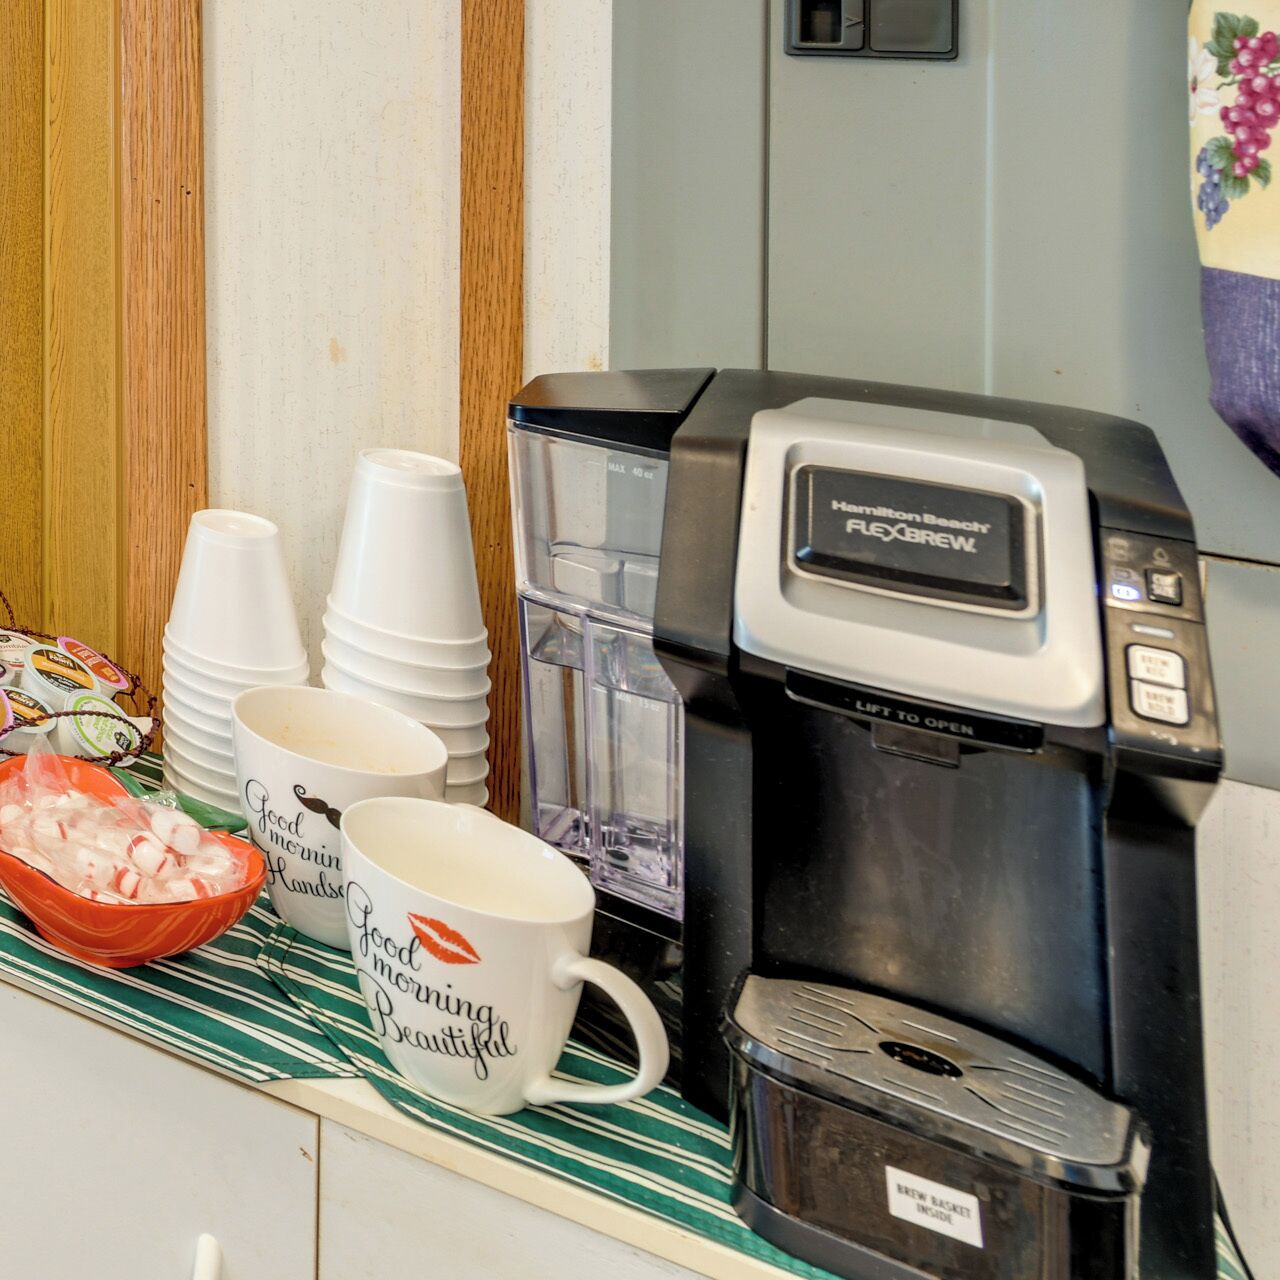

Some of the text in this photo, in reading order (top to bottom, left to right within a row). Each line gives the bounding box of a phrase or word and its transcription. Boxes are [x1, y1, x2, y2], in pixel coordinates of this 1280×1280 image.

[608, 462, 654, 480] MAX 40 oz
[831, 499, 989, 534] Hamilton Beach
[855, 700, 974, 736] LIFT TO OPEN
[245, 779, 306, 840] Good
[269, 828, 342, 871] mornin
[345, 879, 424, 972] Good
[372, 955, 500, 1035] morning
[356, 967, 518, 1081] Beautiful
[896, 1183, 972, 1219] BREW BASKET
[916, 1203, 954, 1226] INSIDE
